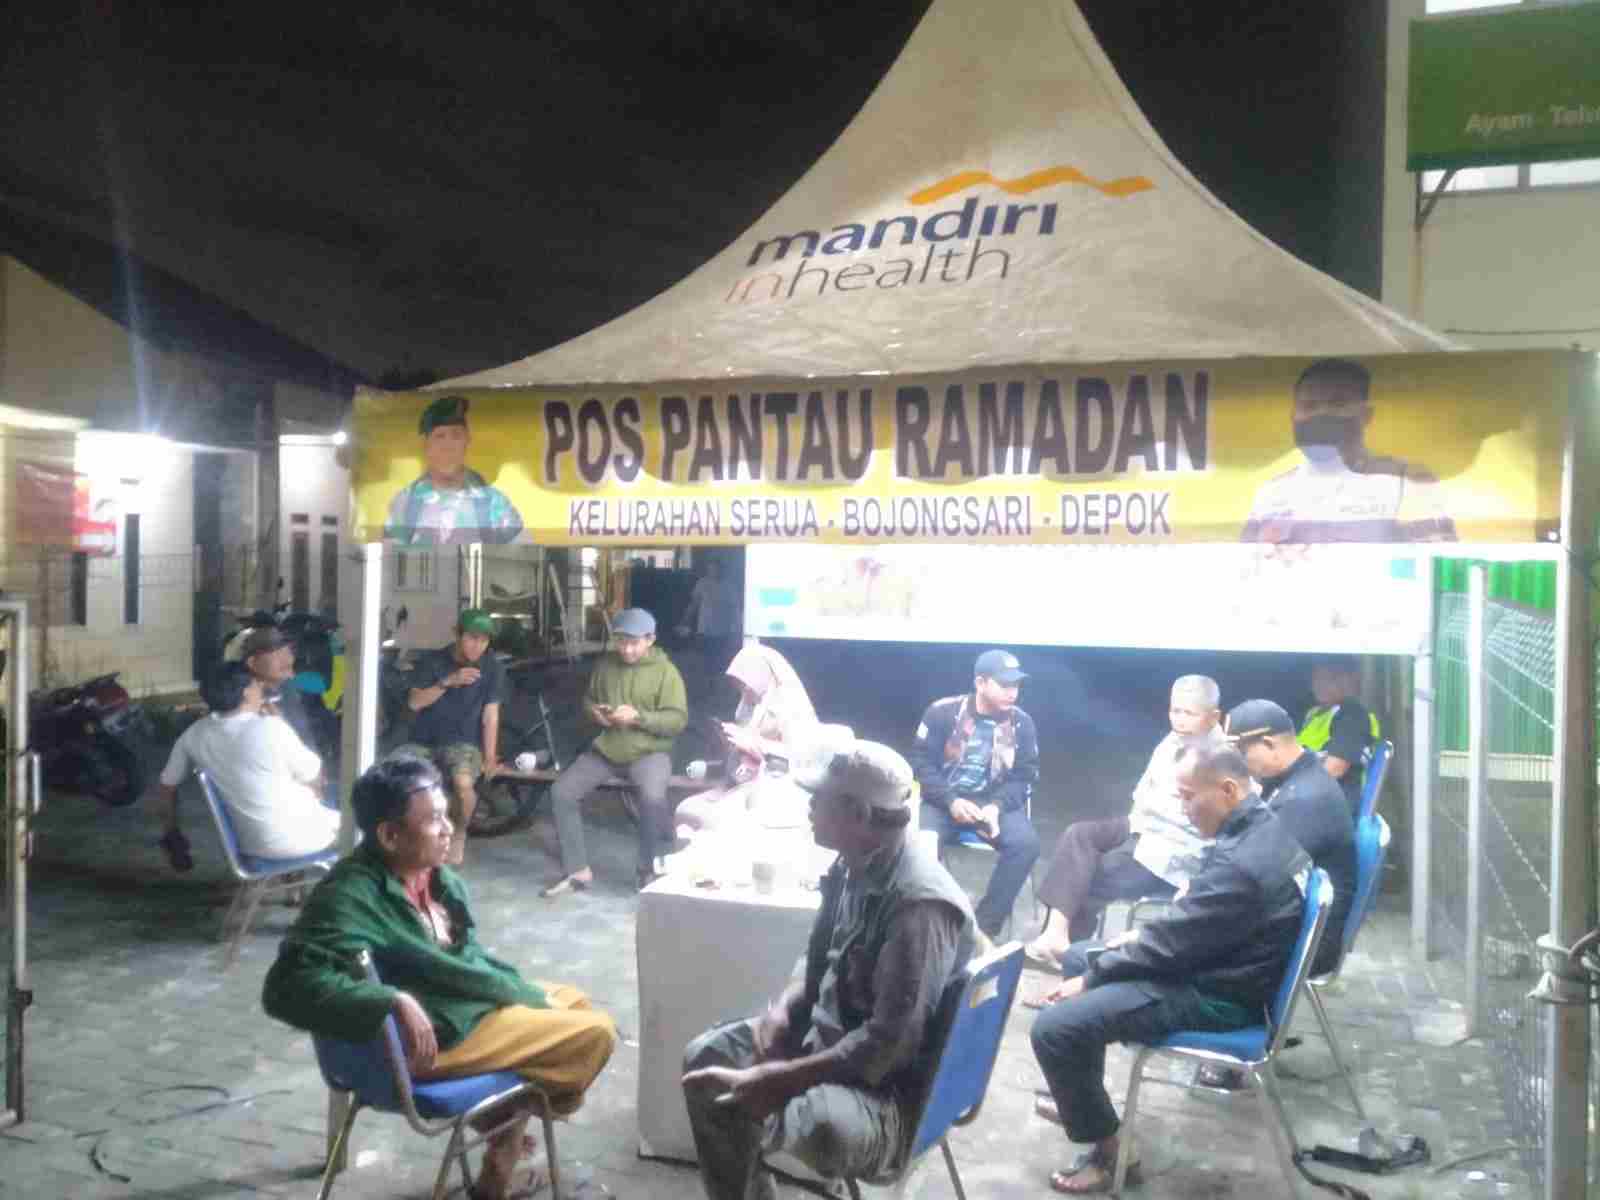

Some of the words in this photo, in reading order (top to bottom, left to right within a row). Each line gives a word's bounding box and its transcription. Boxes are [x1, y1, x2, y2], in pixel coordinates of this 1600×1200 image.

[746, 197, 1058, 266] mandiri
[543, 396, 644, 484] POS
[659, 388, 873, 482] PANTAU
[895, 371, 1209, 478] RAMADAN
[569, 499, 721, 537] KELURAHAN
[730, 498, 819, 537] SERUA
[844, 496, 1032, 537] BOJONGSARI
[1060, 492, 1171, 536] DEPOK
